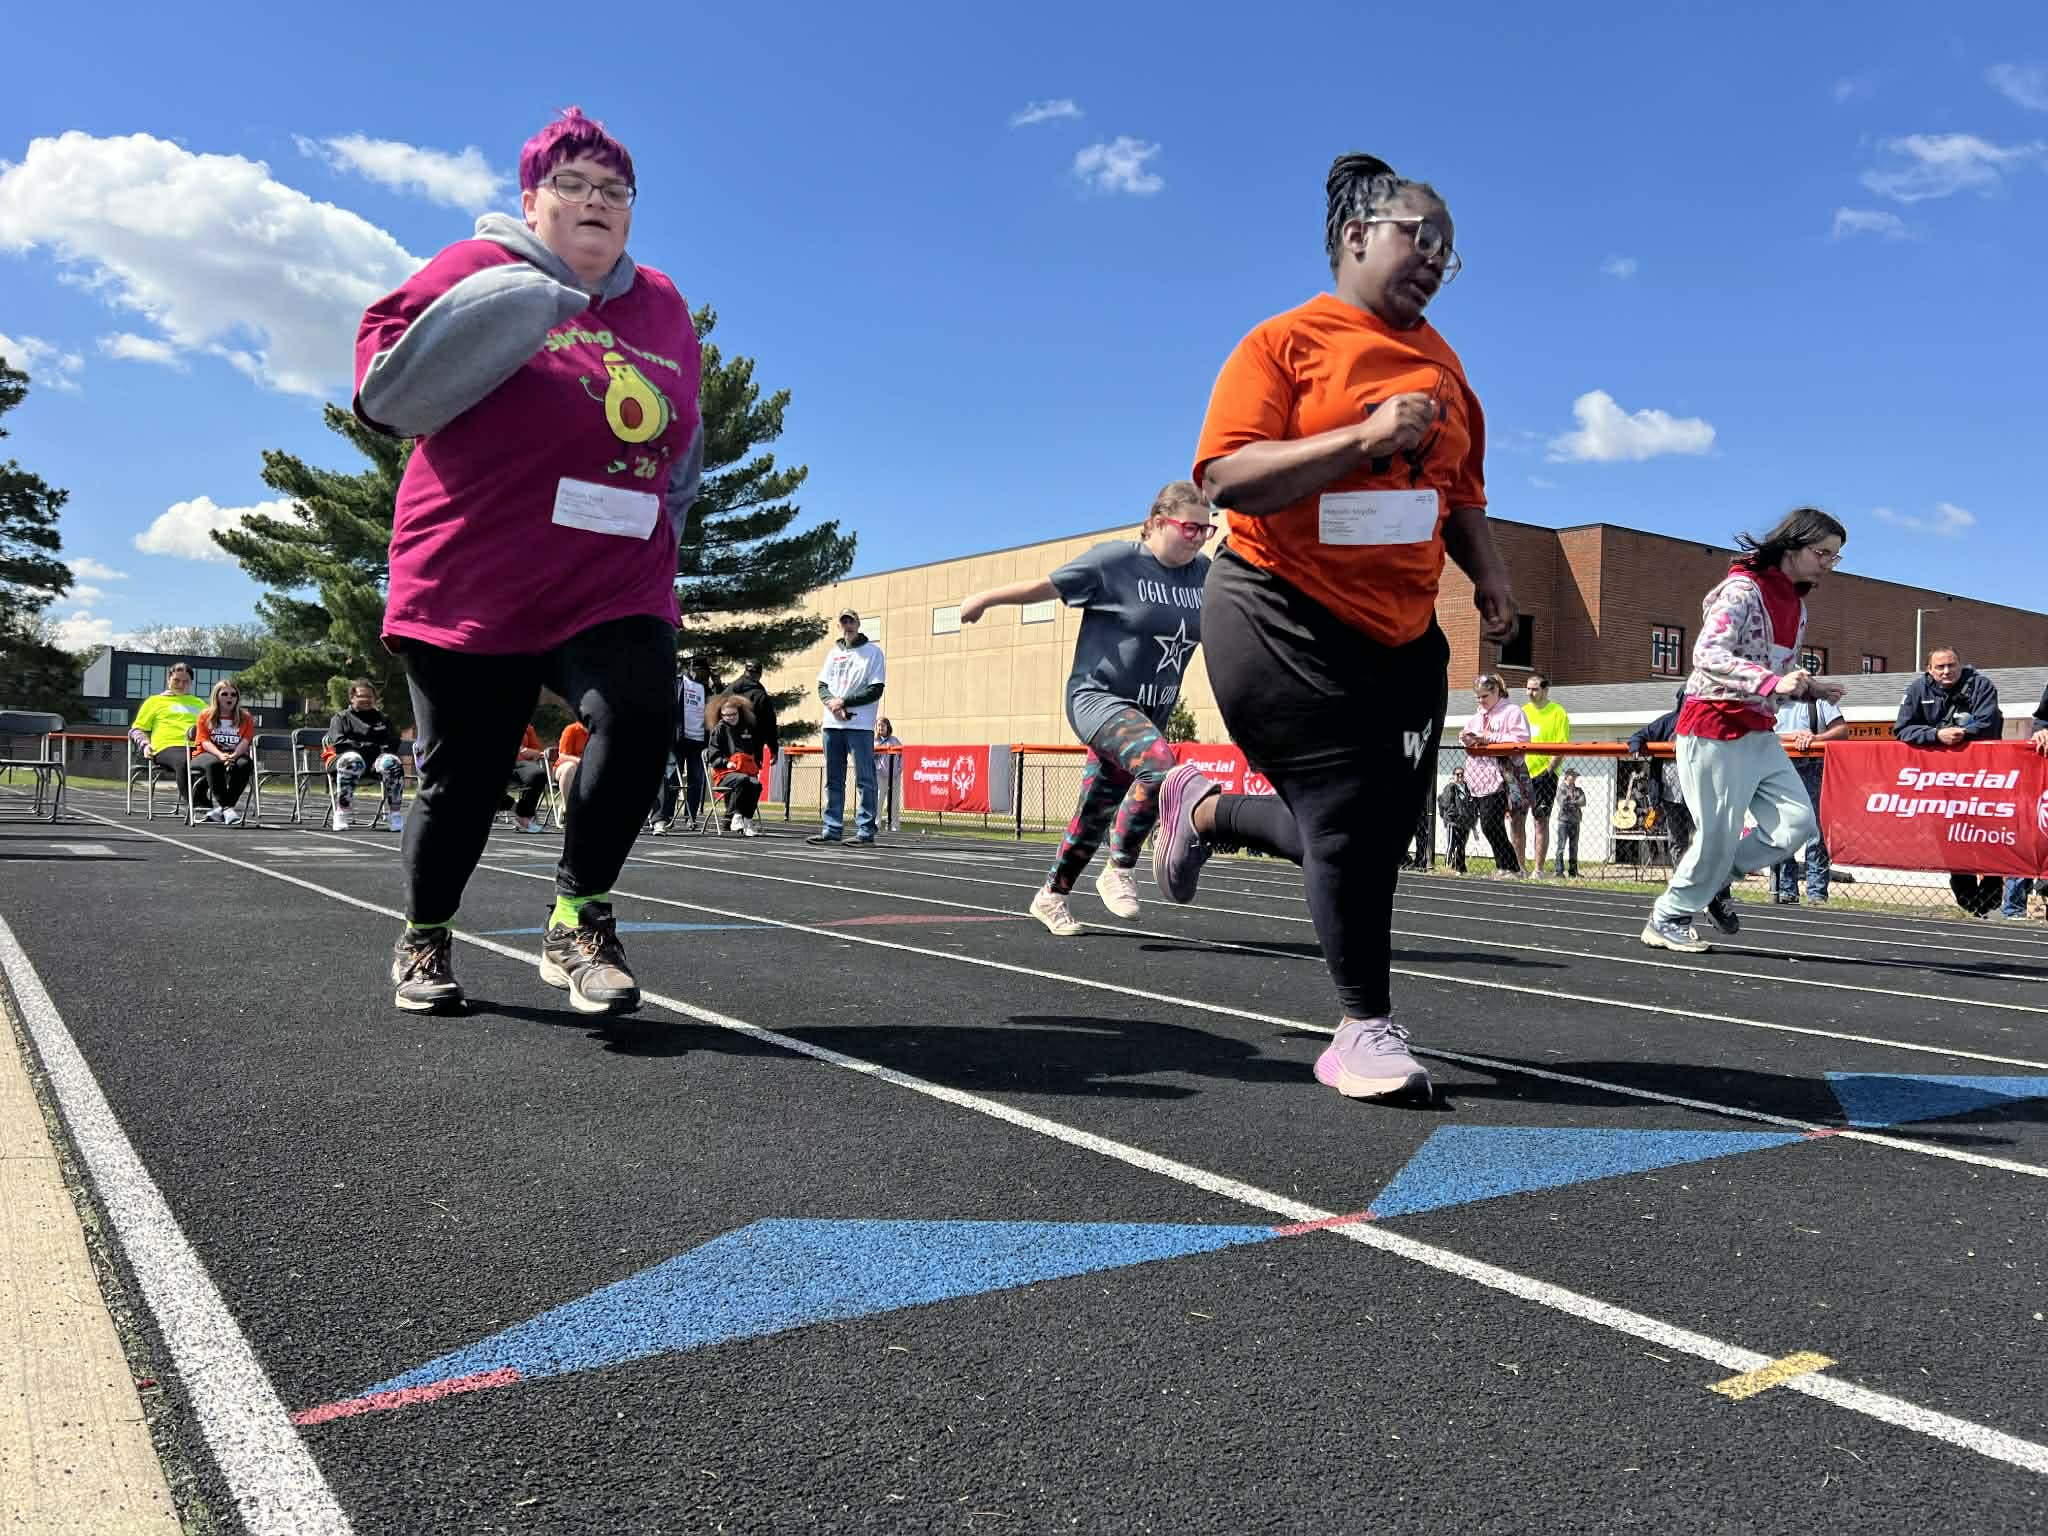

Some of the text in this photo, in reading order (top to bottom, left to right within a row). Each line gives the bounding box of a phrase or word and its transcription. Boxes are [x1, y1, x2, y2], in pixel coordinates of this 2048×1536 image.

[1172, 586, 1203, 609] COUN
[921, 757, 950, 770] Special
[913, 769, 949, 783] Olympics
[1896, 767, 2020, 791] Special
[1866, 793, 2016, 818] Olympics
[1948, 822, 2016, 846] Illinois
